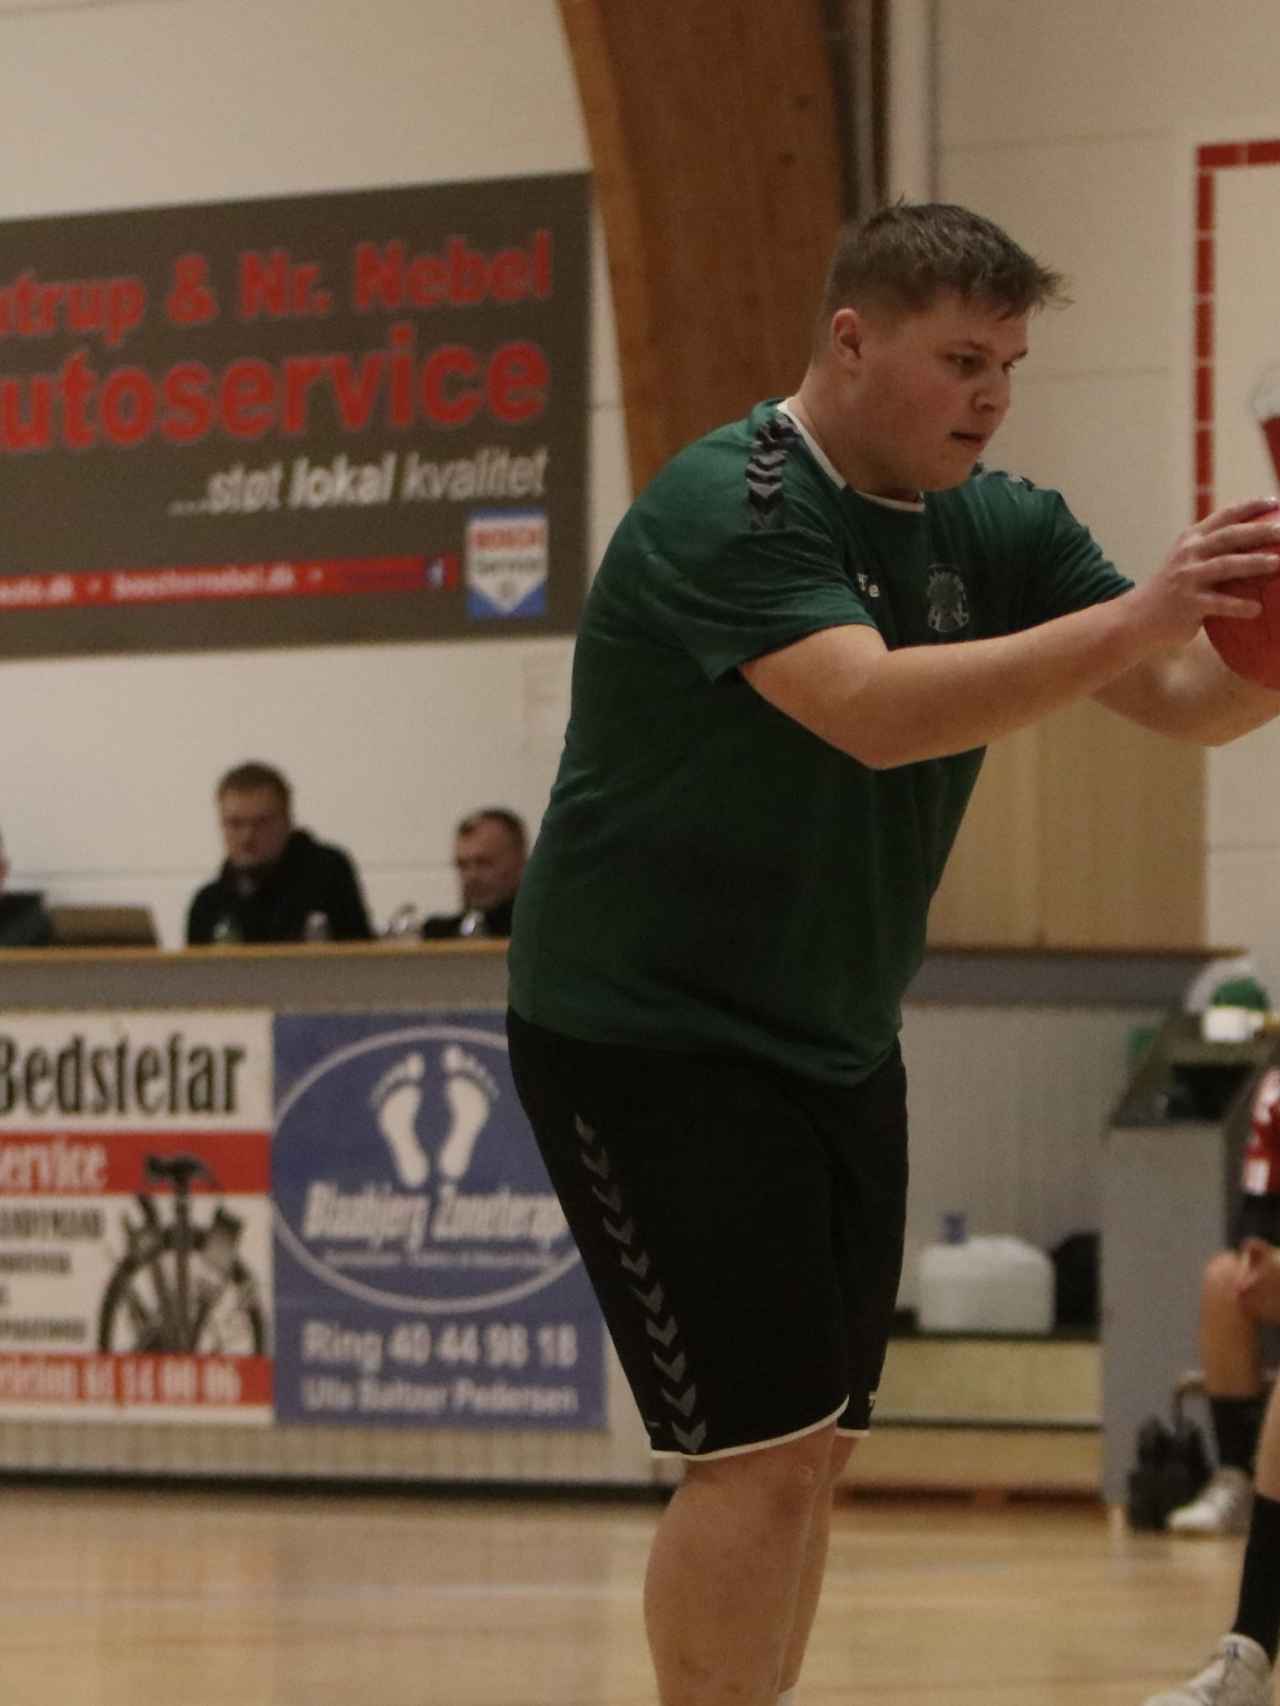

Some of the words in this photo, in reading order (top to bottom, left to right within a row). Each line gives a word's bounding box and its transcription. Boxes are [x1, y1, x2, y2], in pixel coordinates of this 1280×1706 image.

[167, 255, 218, 322] &
[241, 252, 331, 316] Nr.
[353, 230, 551, 307] Nebel
[288, 452, 398, 510] lokal
[402, 446, 550, 500] kvalitet
[303, 1320, 384, 1375] Ring
